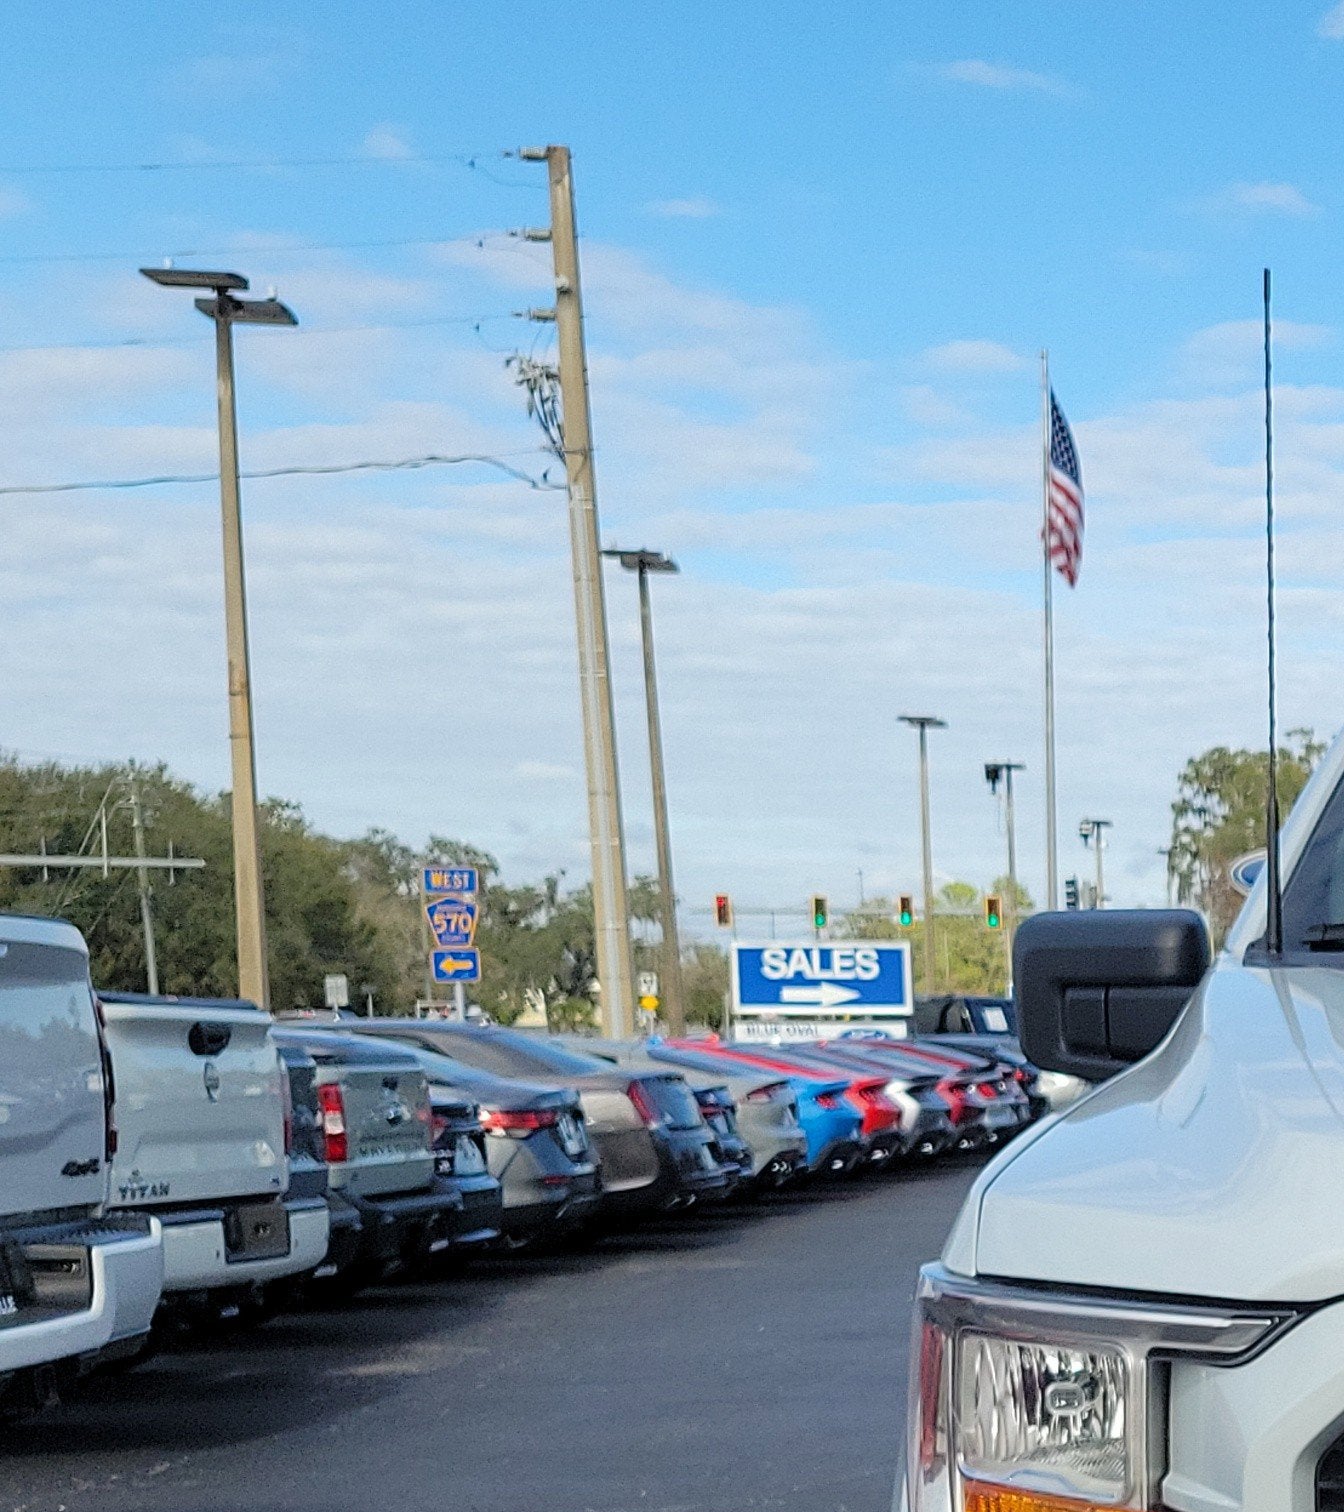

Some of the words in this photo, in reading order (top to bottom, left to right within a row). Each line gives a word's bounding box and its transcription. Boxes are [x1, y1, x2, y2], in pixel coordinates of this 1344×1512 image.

[431, 871, 470, 888] WEST
[433, 911, 472, 934] 570
[760, 948, 881, 981] SALES
[118, 1182, 170, 1200] TITAN
